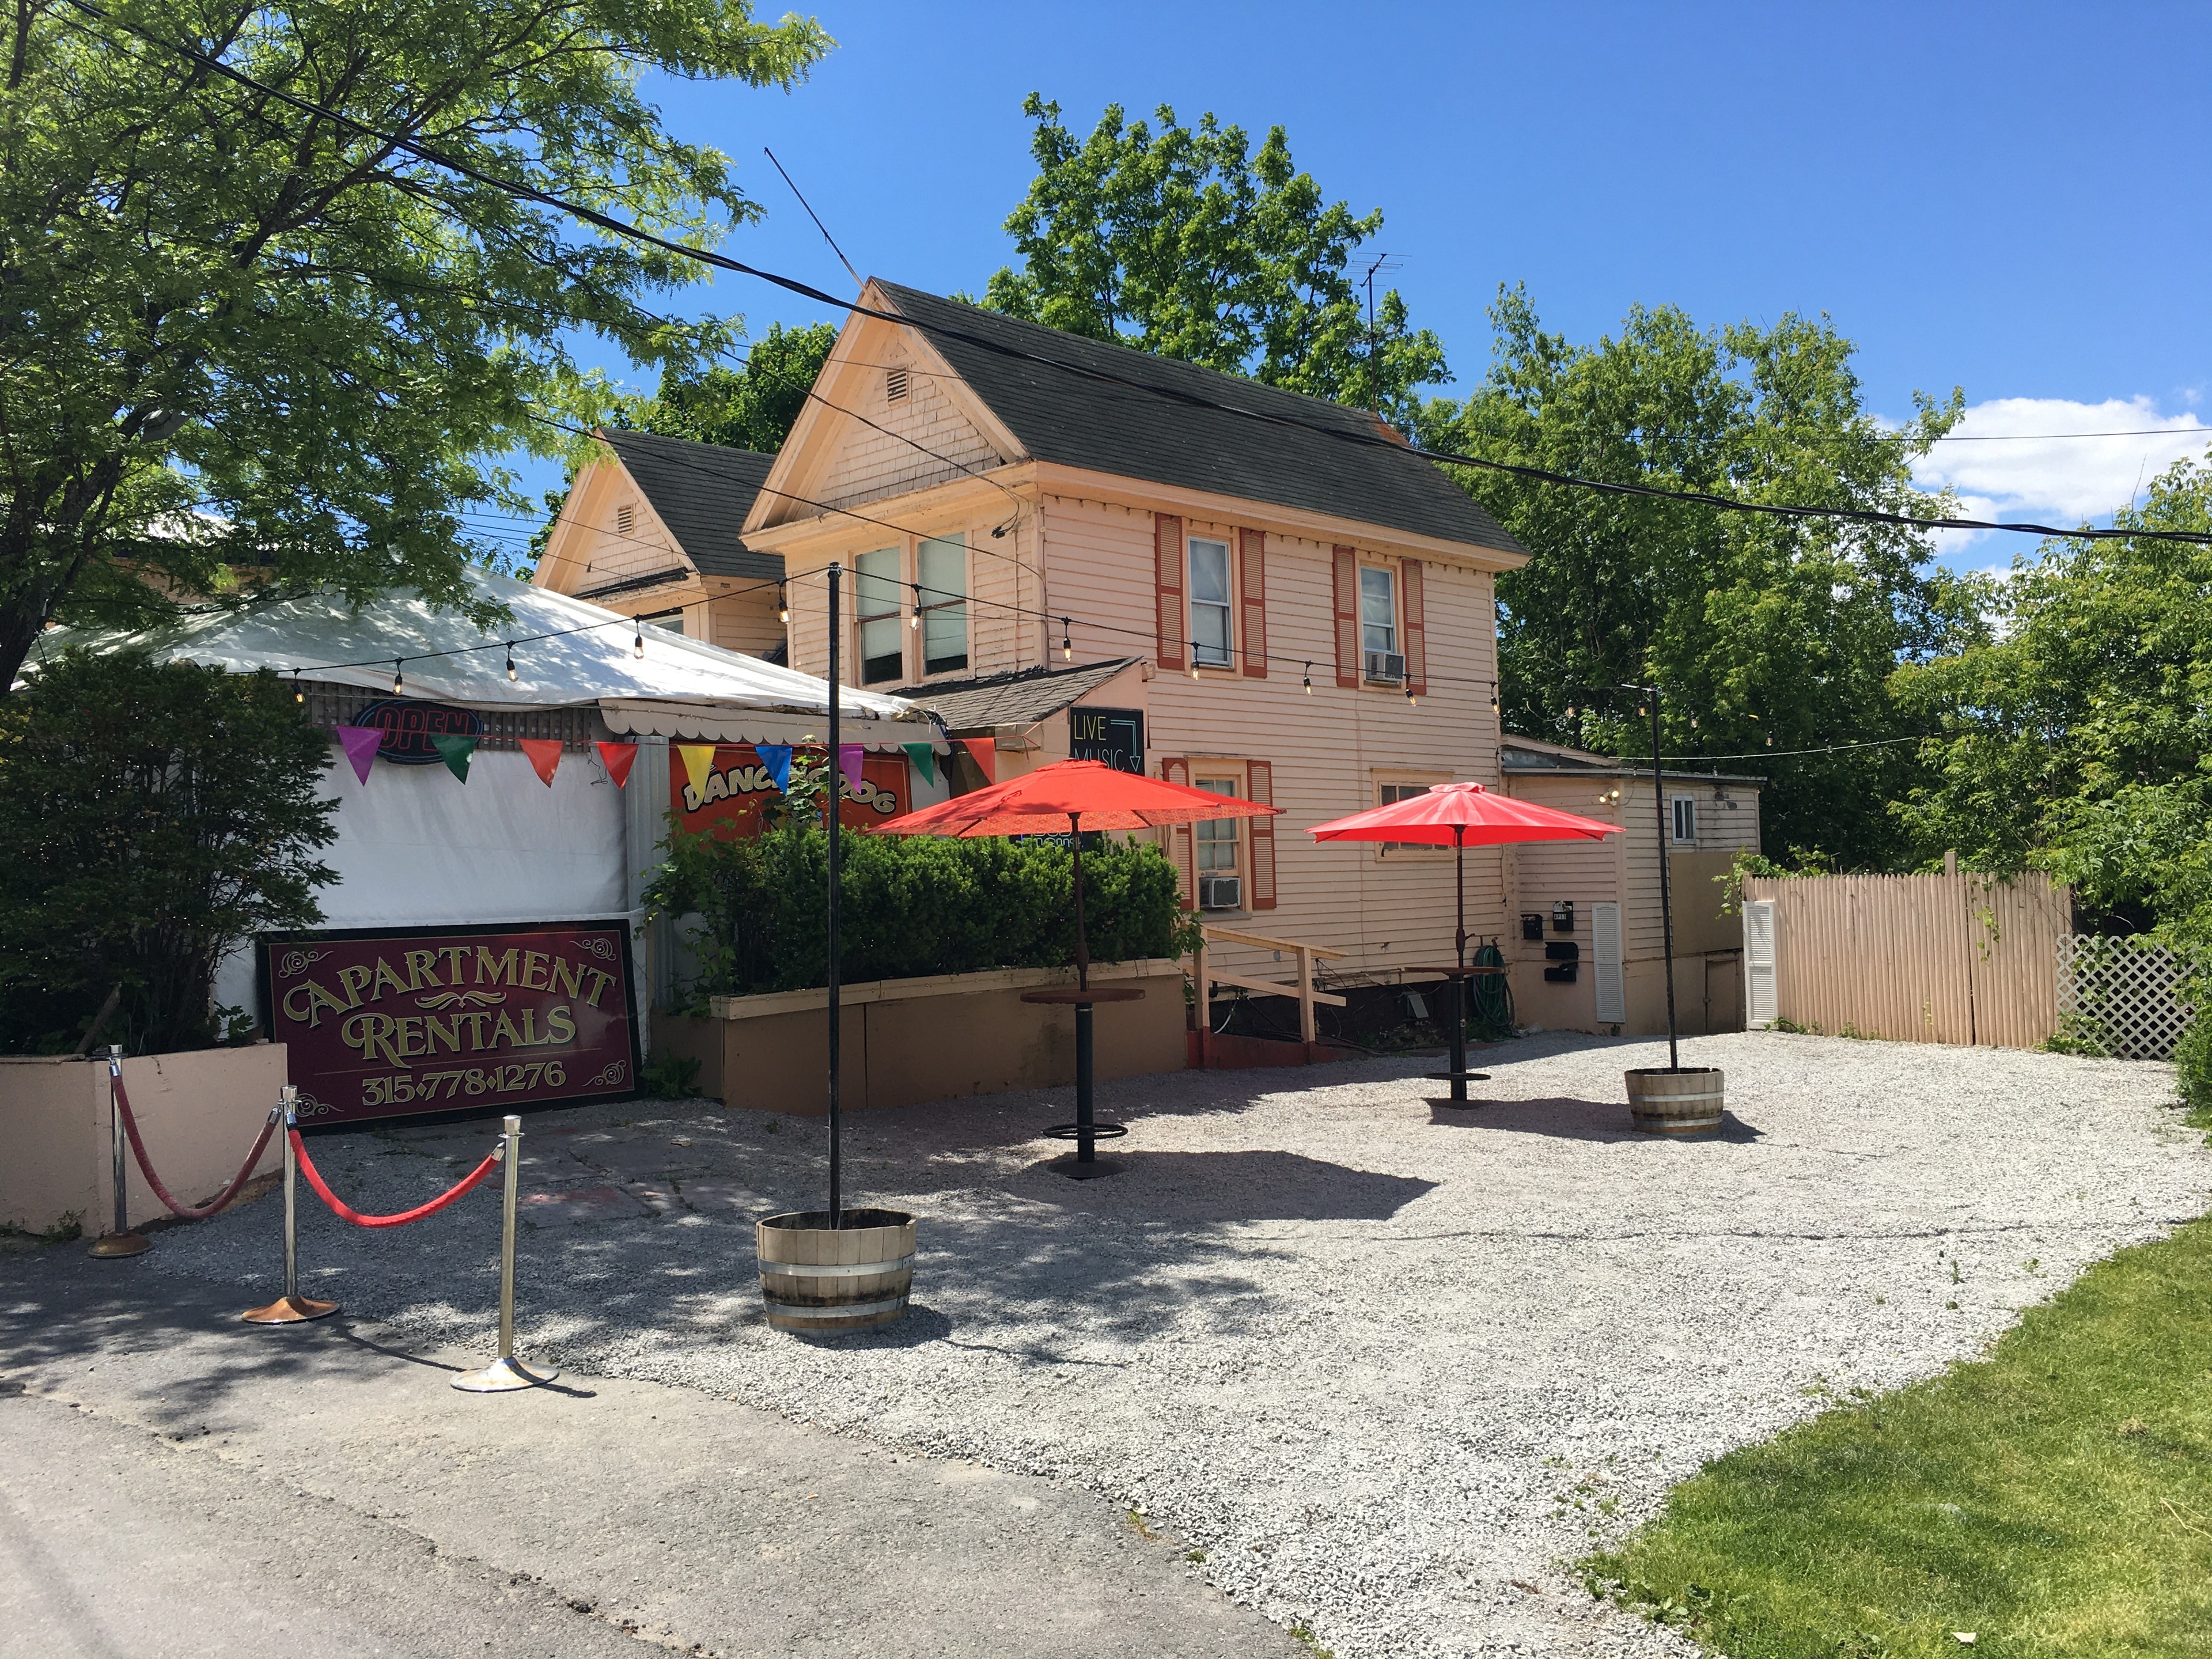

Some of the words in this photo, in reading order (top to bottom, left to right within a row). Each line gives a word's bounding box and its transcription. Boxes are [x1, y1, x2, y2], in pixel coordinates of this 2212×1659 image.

[374, 706, 469, 751] OPEN
[1074, 714, 1107, 741] LIVE
[684, 765, 830, 811] DANC
[283, 946, 617, 1028] APARTMENT
[341, 1005, 575, 1069] RENTALS
